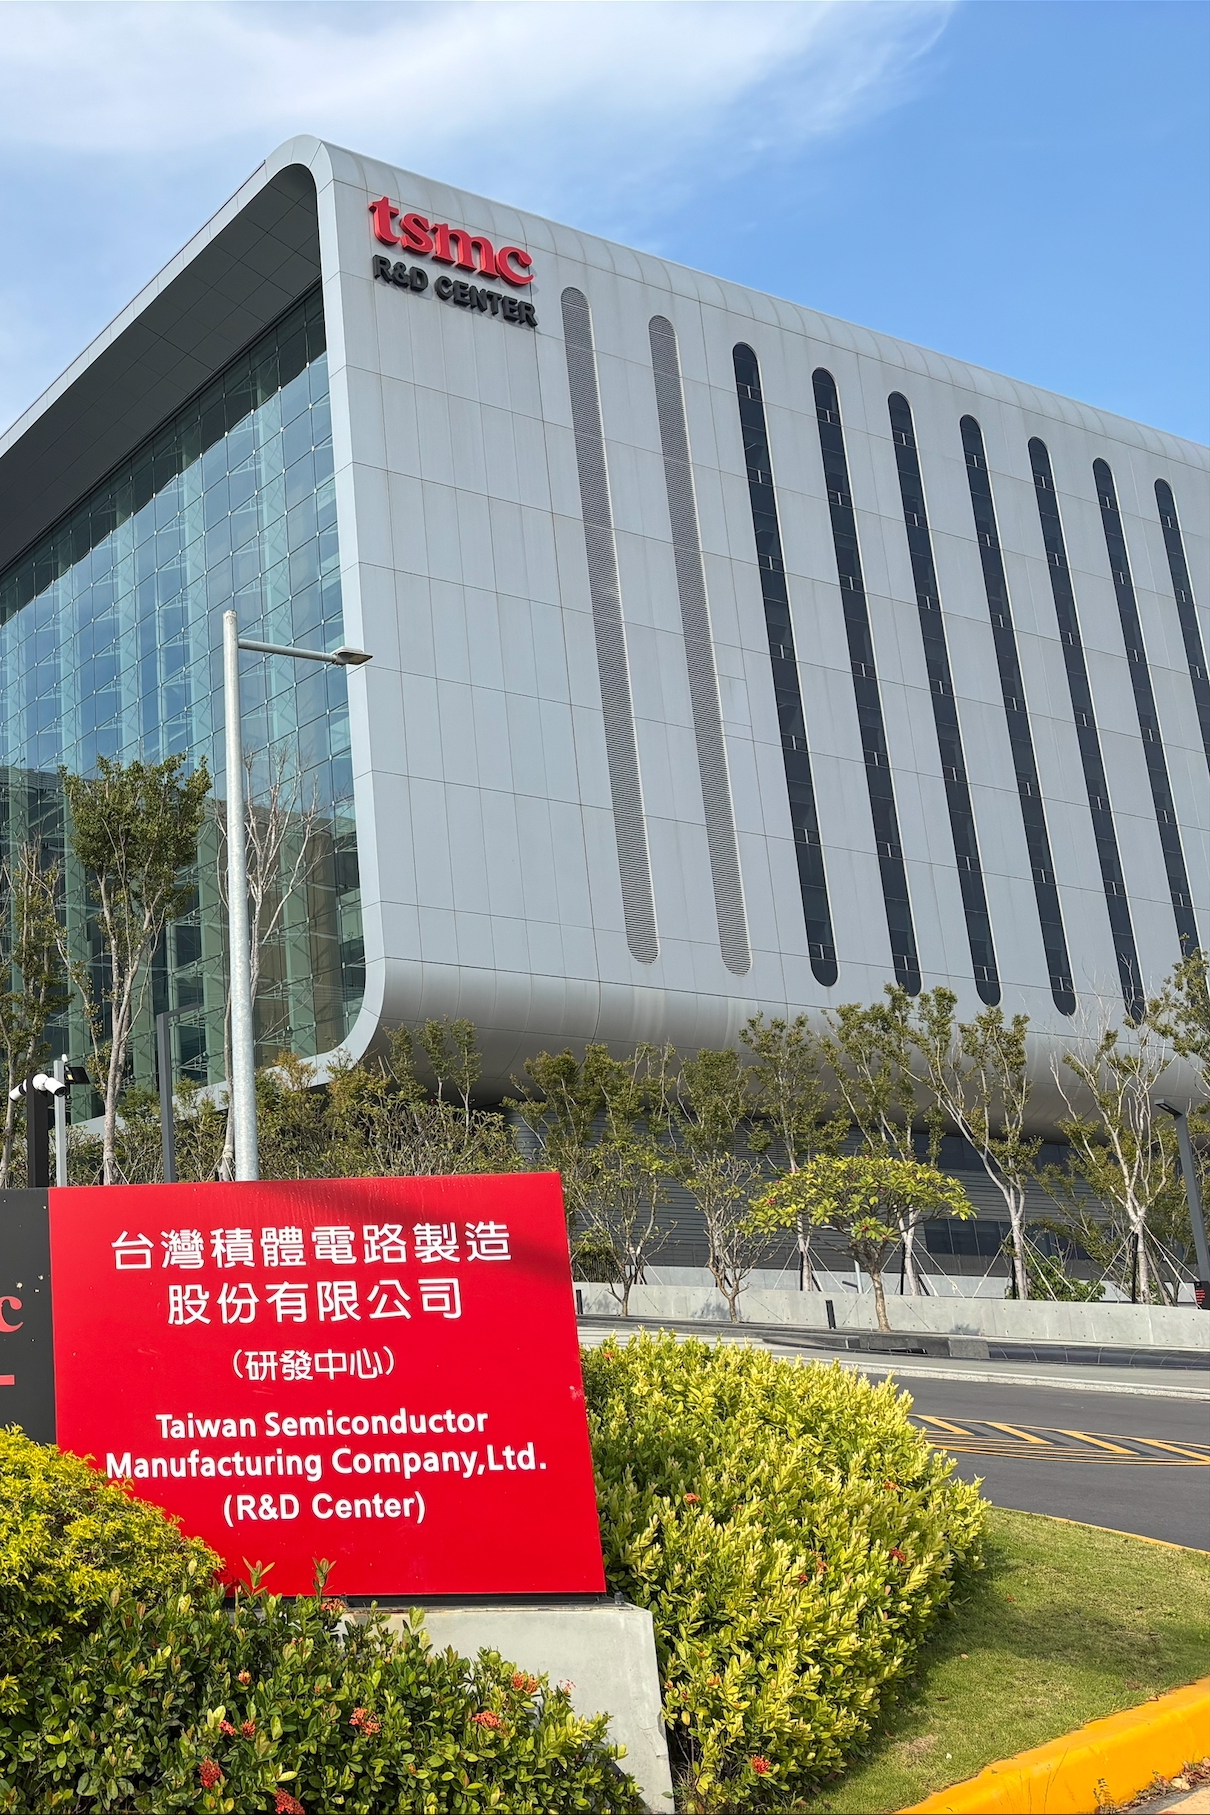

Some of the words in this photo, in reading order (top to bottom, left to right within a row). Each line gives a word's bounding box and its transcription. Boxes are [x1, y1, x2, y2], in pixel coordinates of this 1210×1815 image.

[369, 196, 534, 287] tsmc
[372, 254, 429, 292] R&D
[434, 275, 538, 327] CENTER
[110, 1220, 512, 1271] 台灣積體電路製造
[167, 1277, 463, 1326] 股份有限公司
[155, 1412, 257, 1439] Taiwan
[264, 1408, 488, 1437] Semiconductor
[106, 1447, 323, 1482] Manufacturing
[331, 1441, 548, 1479] Company,Ltd.
[223, 1493, 300, 1528] (R&D
[311, 1490, 426, 1524] Center)
